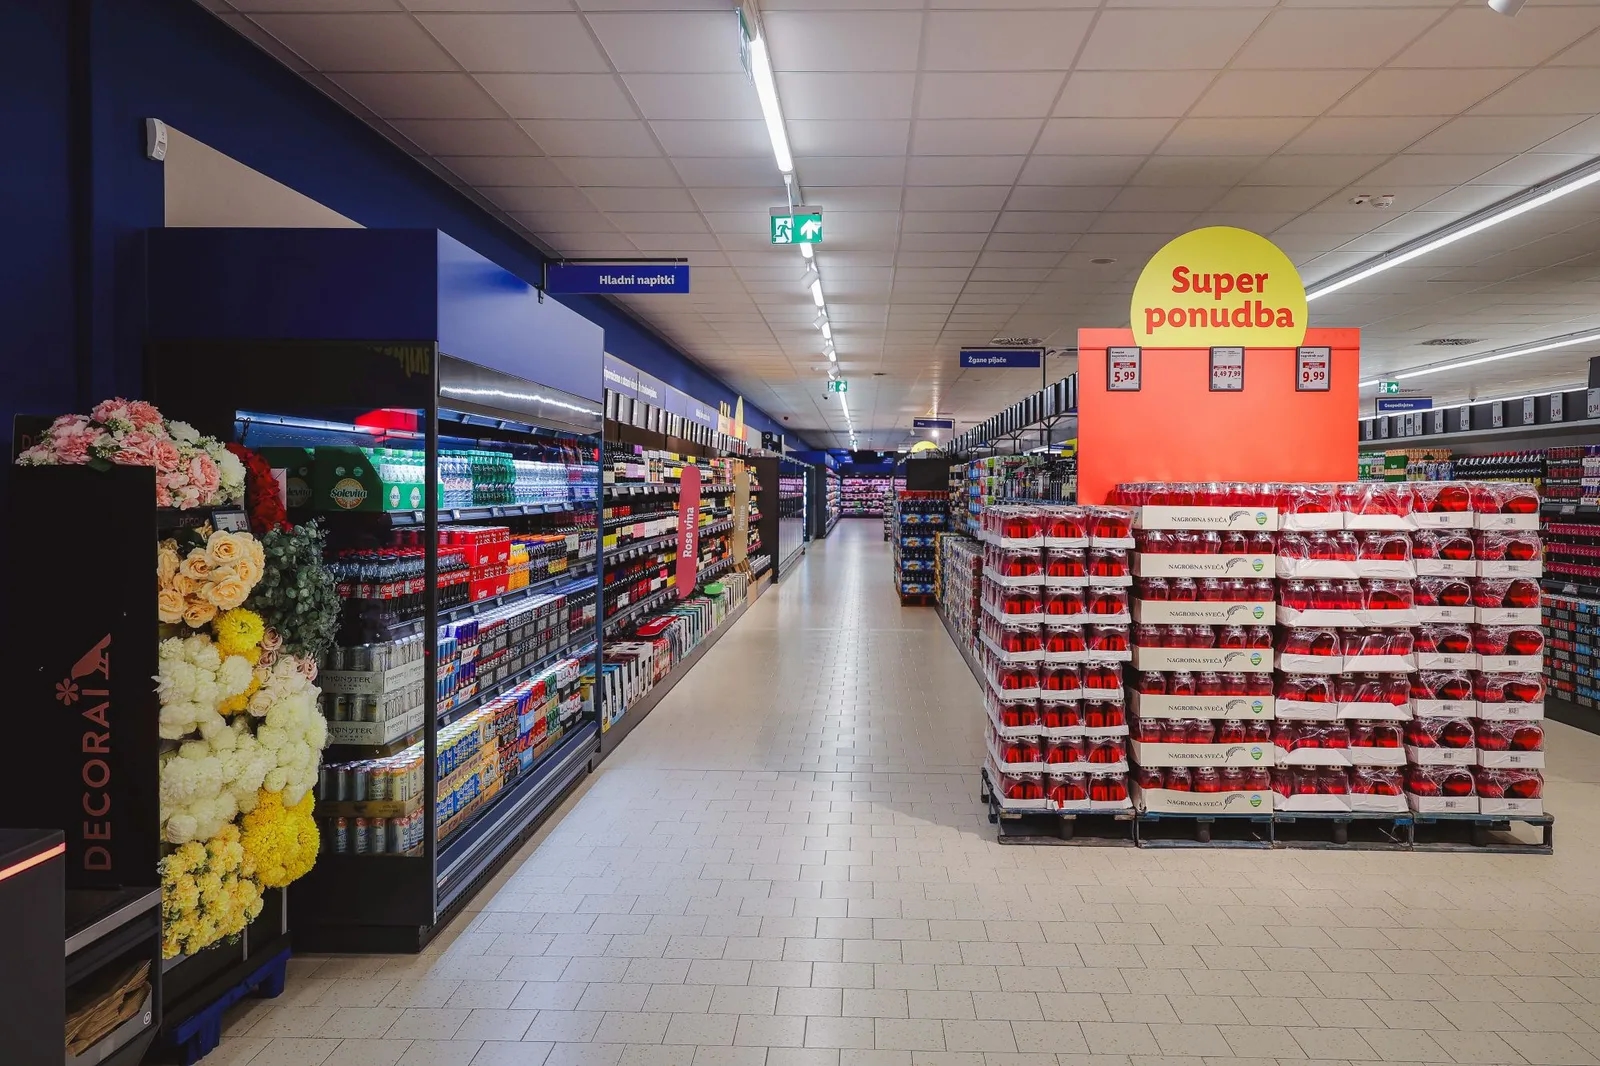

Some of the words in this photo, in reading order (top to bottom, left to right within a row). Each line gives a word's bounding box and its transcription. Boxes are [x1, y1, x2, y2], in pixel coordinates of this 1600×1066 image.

[599, 274, 635, 286] Hladni
[637, 274, 675, 287] napitki
[1171, 266, 1269, 300] Super
[1144, 300, 1295, 335] ponudba
[968, 355, 988, 364] Žgane
[988, 356, 1007, 364] pijače
[1114, 371, 1136, 382] 5.99
[1228, 370, 1241, 378] 7.99
[1302, 371, 1325, 382] 9.99
[330, 487, 367, 500] Solevita
[684, 507, 695, 530] vina
[738, 505, 746, 531] Penine
[682, 532, 694, 558] Rose
[81, 689, 112, 870] DECORAI
[1166, 799, 1202, 807] NAGROBNA
[1203, 799, 1223, 807] SVEČA
